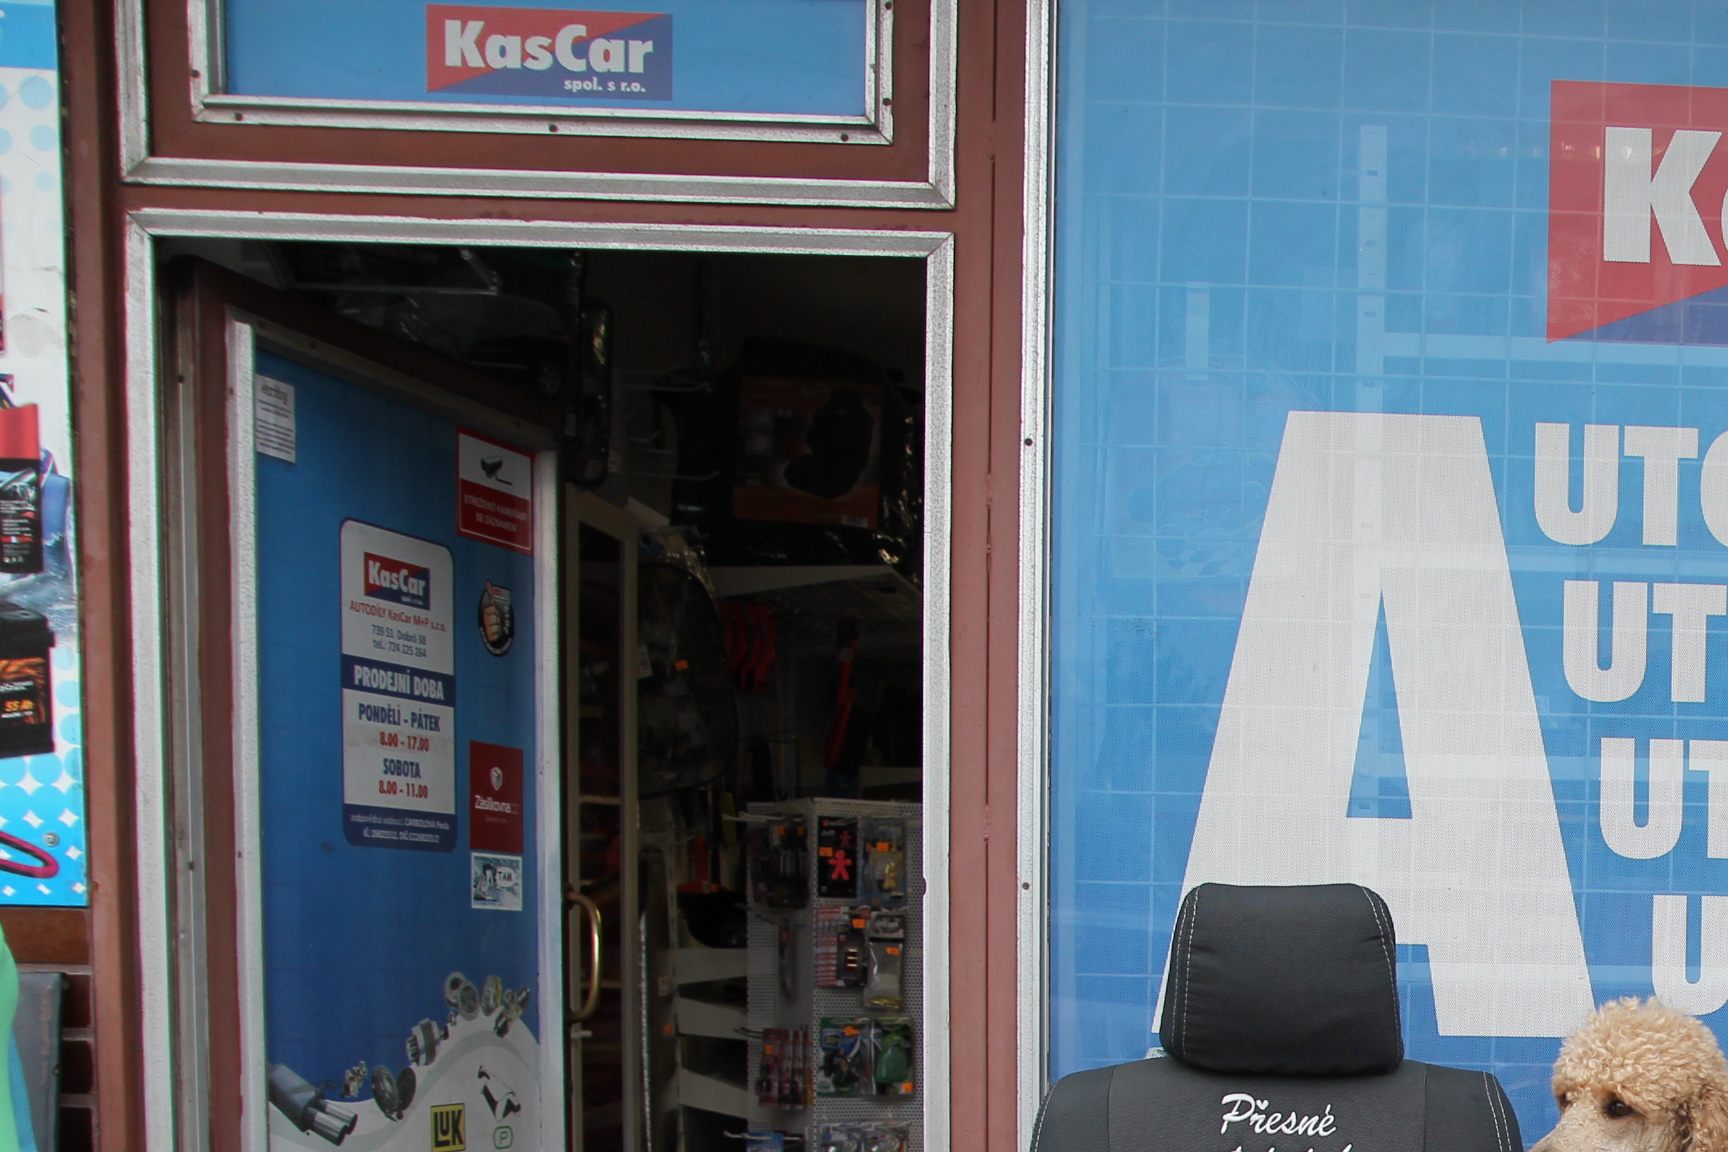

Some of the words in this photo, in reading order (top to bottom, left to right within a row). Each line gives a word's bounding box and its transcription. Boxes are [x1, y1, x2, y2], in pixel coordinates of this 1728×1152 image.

[444, 19, 653, 74] KasCar
[563, 77, 602, 92] spol.
[607, 81, 616, 91] s
[620, 82, 646, 92] r.o.
[368, 560, 426, 596] KasCar
[349, 600, 386, 618] AUTODÍLY
[354, 664, 411, 695] PRODEJNÍ
[413, 676, 445, 701] DOBA
[358, 702, 401, 726] PONDĚLÍ
[411, 708, 441, 733] PÁTEK
[380, 731, 399, 748] 8.00
[407, 735, 430, 752] 17.00
[383, 757, 421, 779] SOBOTA
[379, 780, 398, 795] 8.00
[406, 782, 429, 799] 11.00
[1220, 1092, 1337, 1137] Přesné
